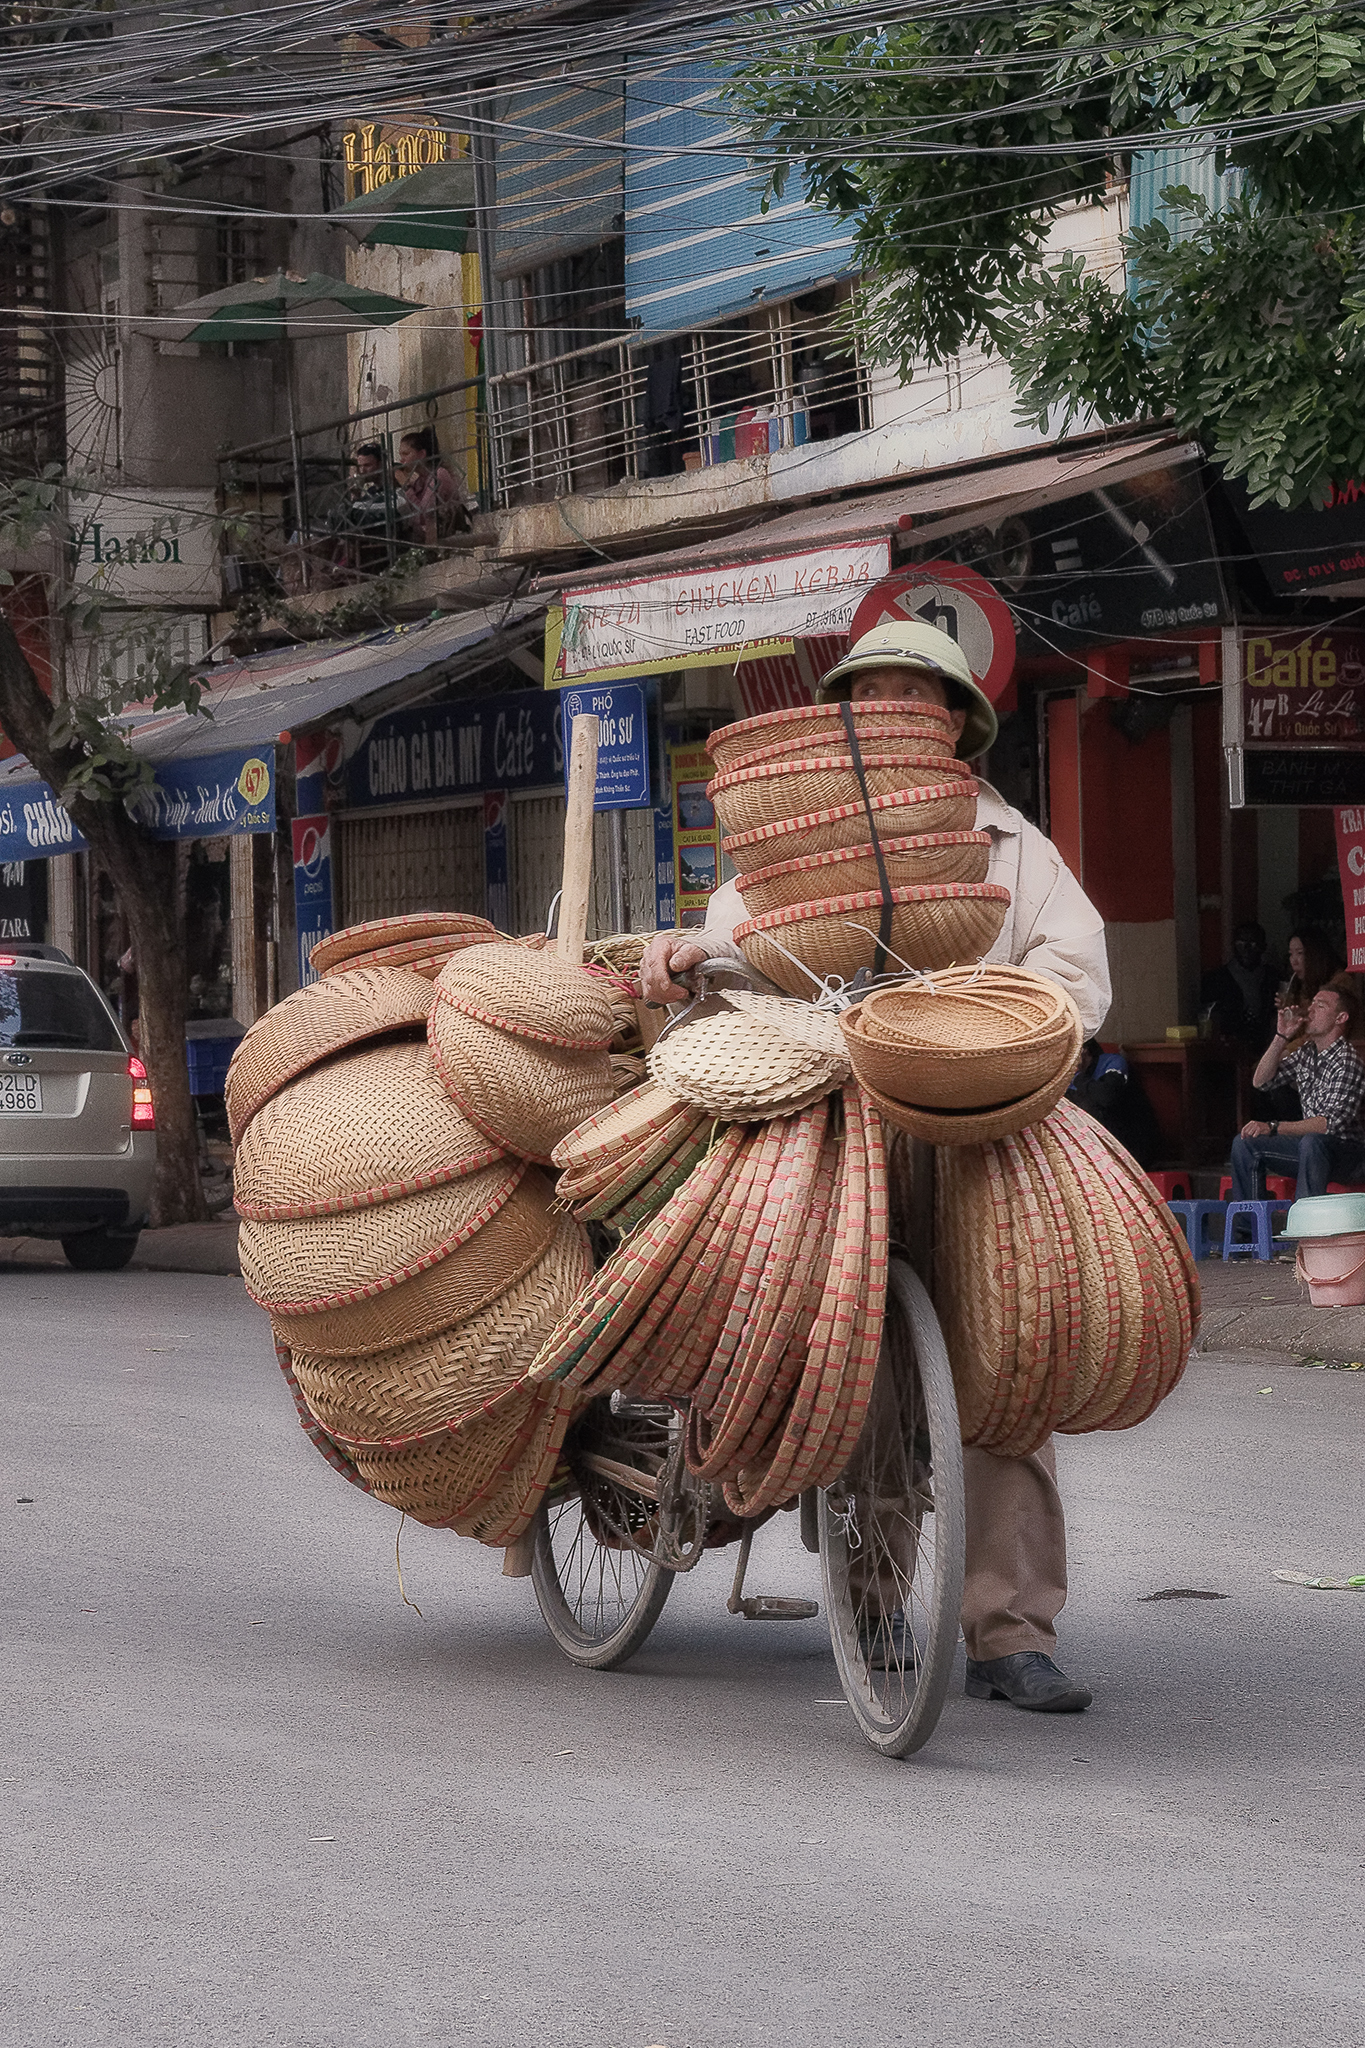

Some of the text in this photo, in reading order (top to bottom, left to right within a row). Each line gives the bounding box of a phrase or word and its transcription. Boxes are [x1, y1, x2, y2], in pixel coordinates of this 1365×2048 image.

[793, 561, 870, 596] KEBAB
[1051, 592, 1102, 626] Café
[1140, 607, 1164, 626] 47B
[685, 618, 746, 646] FAST FOOD
[1246, 637, 1337, 688] Café
[592, 689, 614, 712] PHỐ
[597, 711, 616, 747] UỐC
[618, 713, 635, 745] SƯ
[368, 724, 407, 797] CHÁO
[494, 708, 534, 778] Café
[1, 917, 31, 938] ZARA
[0, 1075, 36, 1092] 2LD
